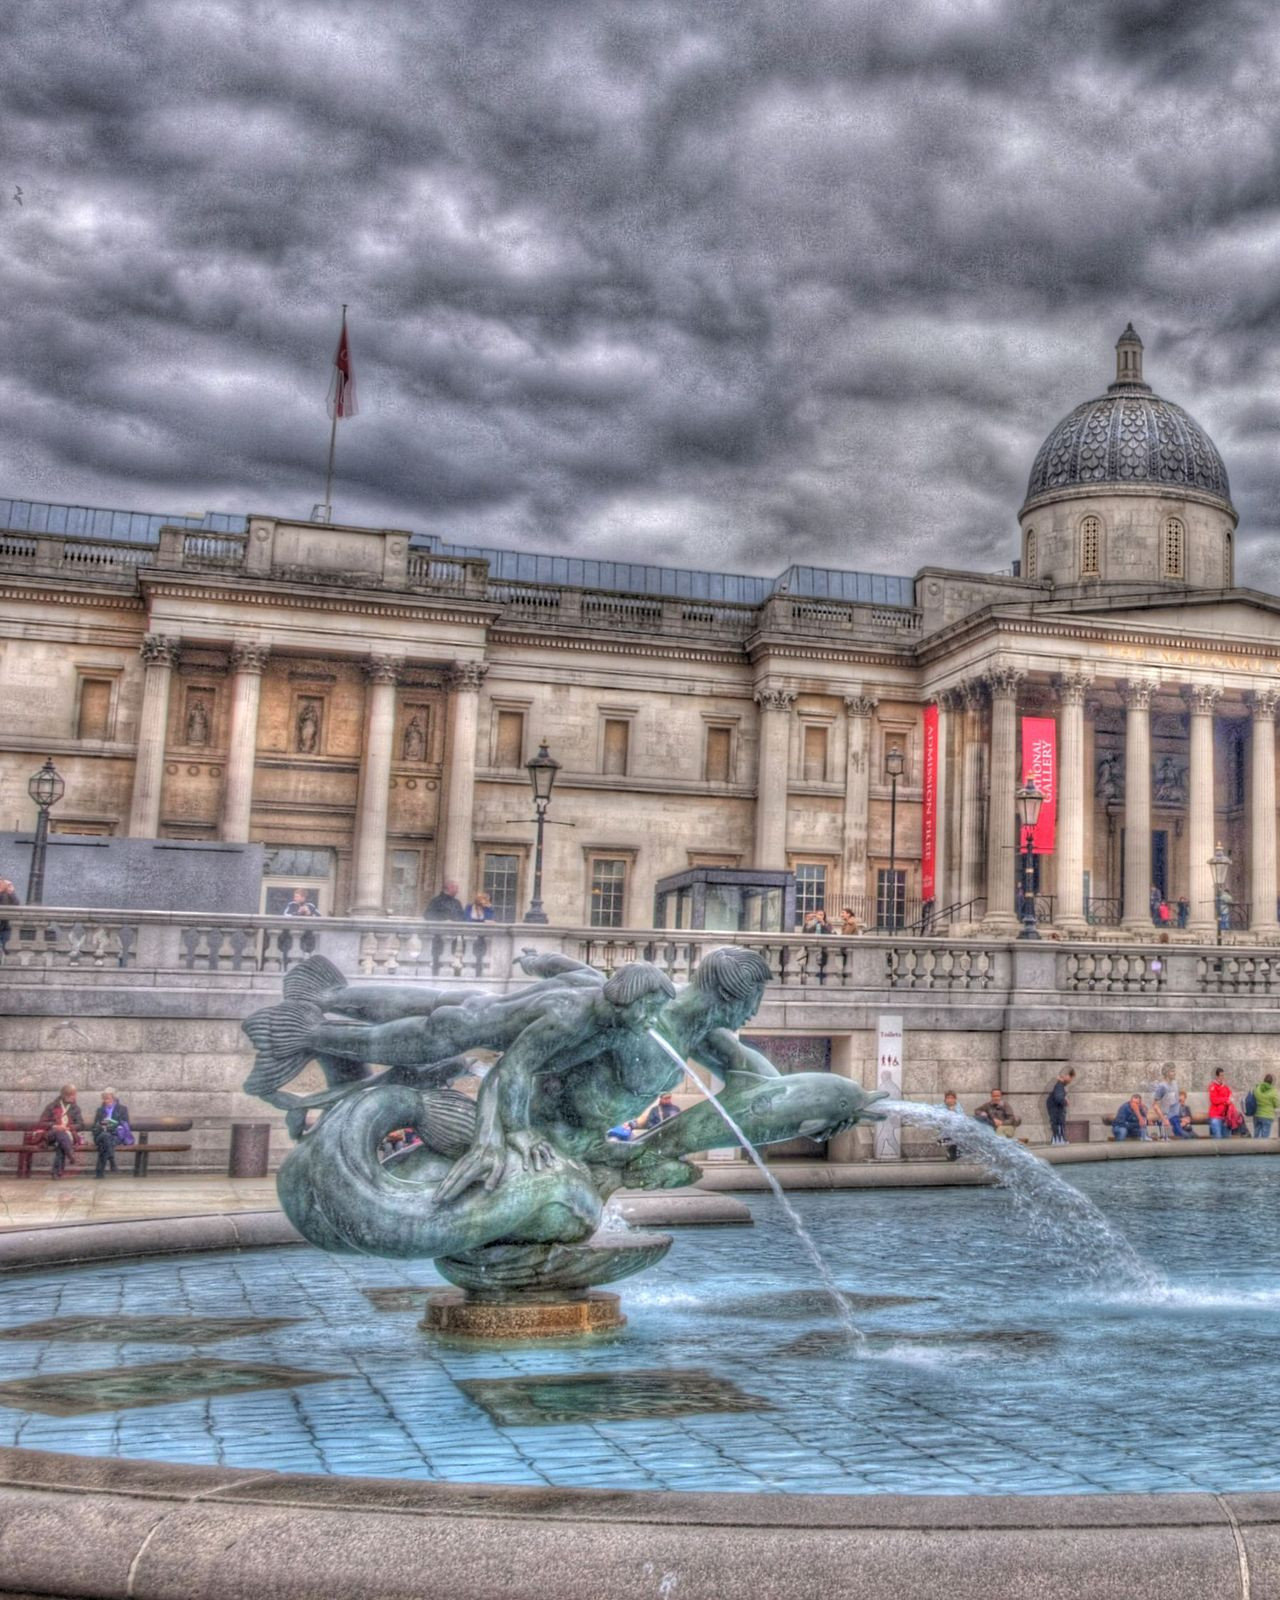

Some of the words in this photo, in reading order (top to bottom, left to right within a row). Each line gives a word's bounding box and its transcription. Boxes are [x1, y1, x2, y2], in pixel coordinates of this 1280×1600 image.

[1105, 645, 1147, 661] THE
[1161, 651, 1262, 672] NATIONAL
[926, 726, 934, 814] ADMISSION
[1032, 740, 1042, 792] ATIONAL
[1042, 740, 1053, 803] GALLERY
